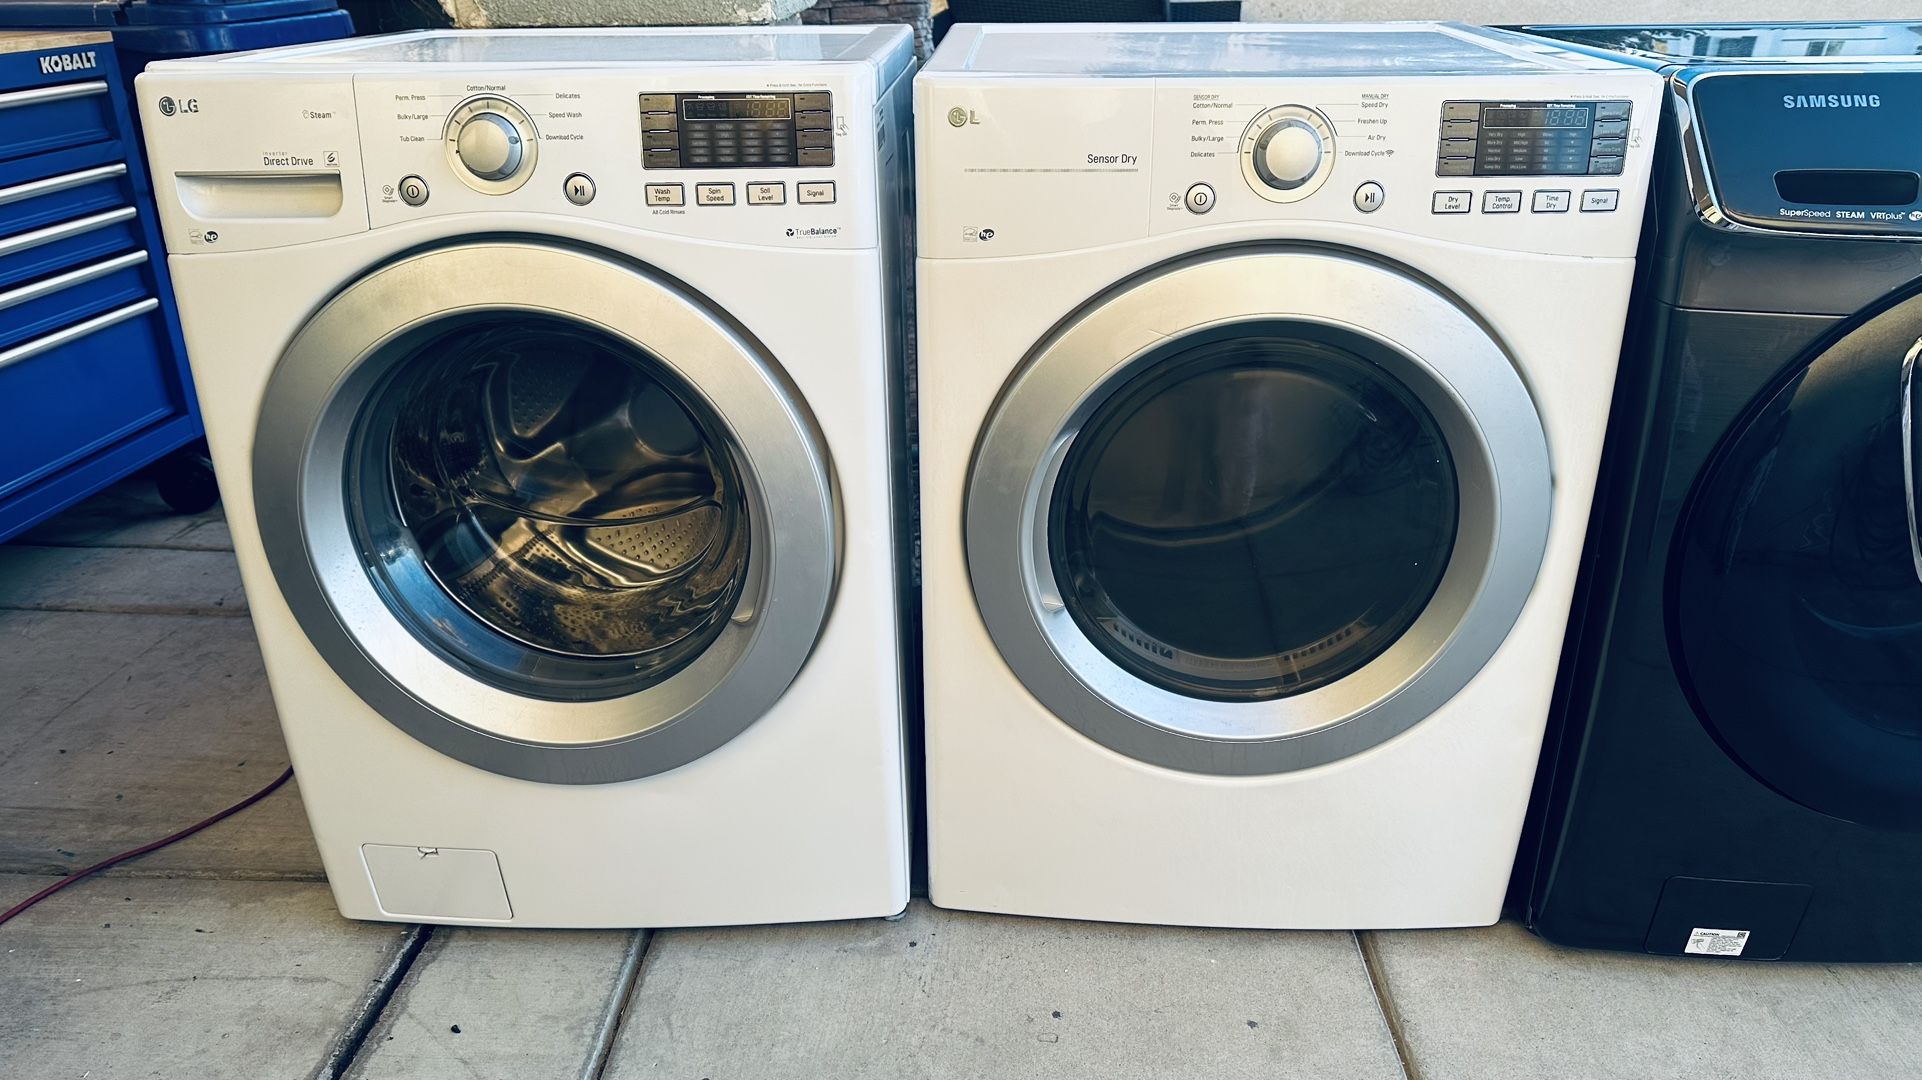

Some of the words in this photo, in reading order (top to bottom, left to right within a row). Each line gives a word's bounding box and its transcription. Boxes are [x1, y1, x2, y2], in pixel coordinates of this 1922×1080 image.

[40, 51, 96, 74] KOBALT
[178, 98, 199, 113] LG
[1783, 94, 1880, 108] SAMSUNG
[263, 156, 290, 166] Direct
[291, 156, 314, 166] Drive
[1087, 154, 1119, 164] Sensor
[1121, 154, 1137, 165] Dry
[706, 194, 724, 202] Speed
[1448, 196, 1458, 204] Dry
[1591, 197, 1608, 205] Signal
[1492, 202, 1513, 210] Control
[1546, 202, 1556, 210] Dry
[1780, 208, 1831, 218] SuperSpeed
[1836, 211, 1865, 219] STEAM
